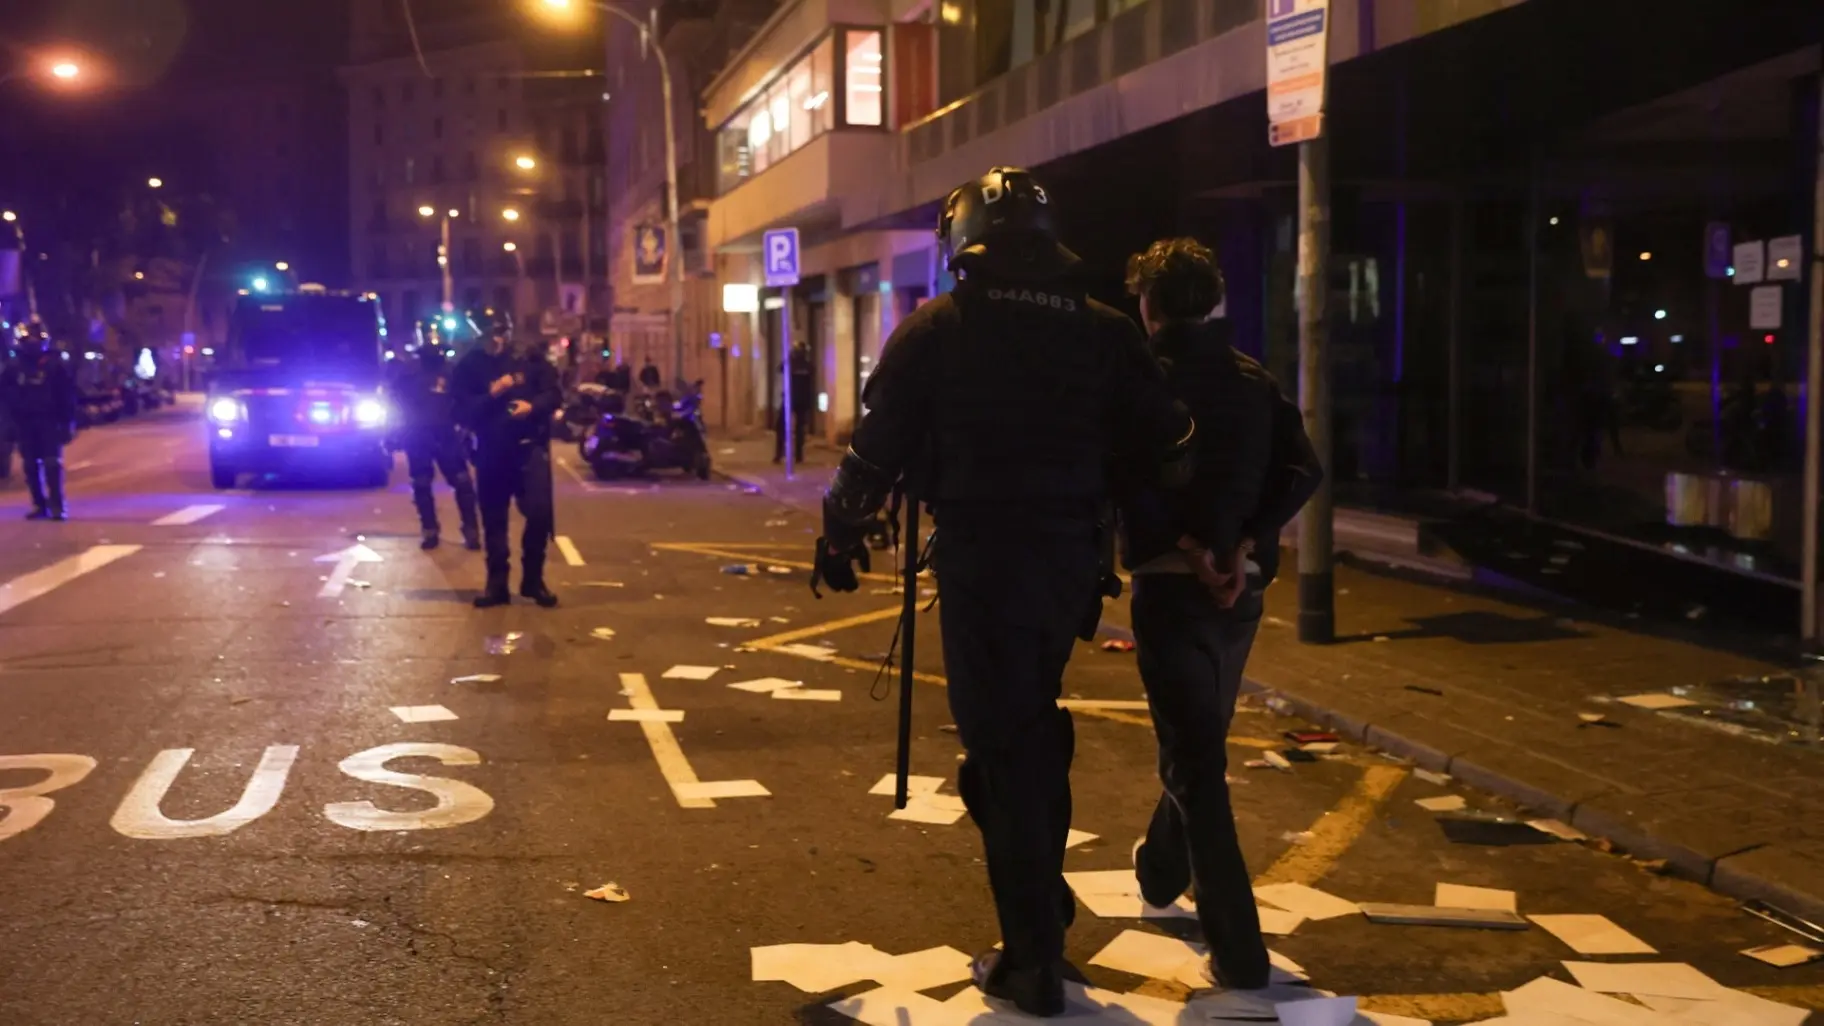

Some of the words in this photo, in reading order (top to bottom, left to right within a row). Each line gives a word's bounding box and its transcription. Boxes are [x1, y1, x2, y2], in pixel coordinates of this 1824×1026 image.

[1033, 185, 1048, 205] 3
[769, 235, 792, 272] P
[0, 742, 495, 842] BUS
